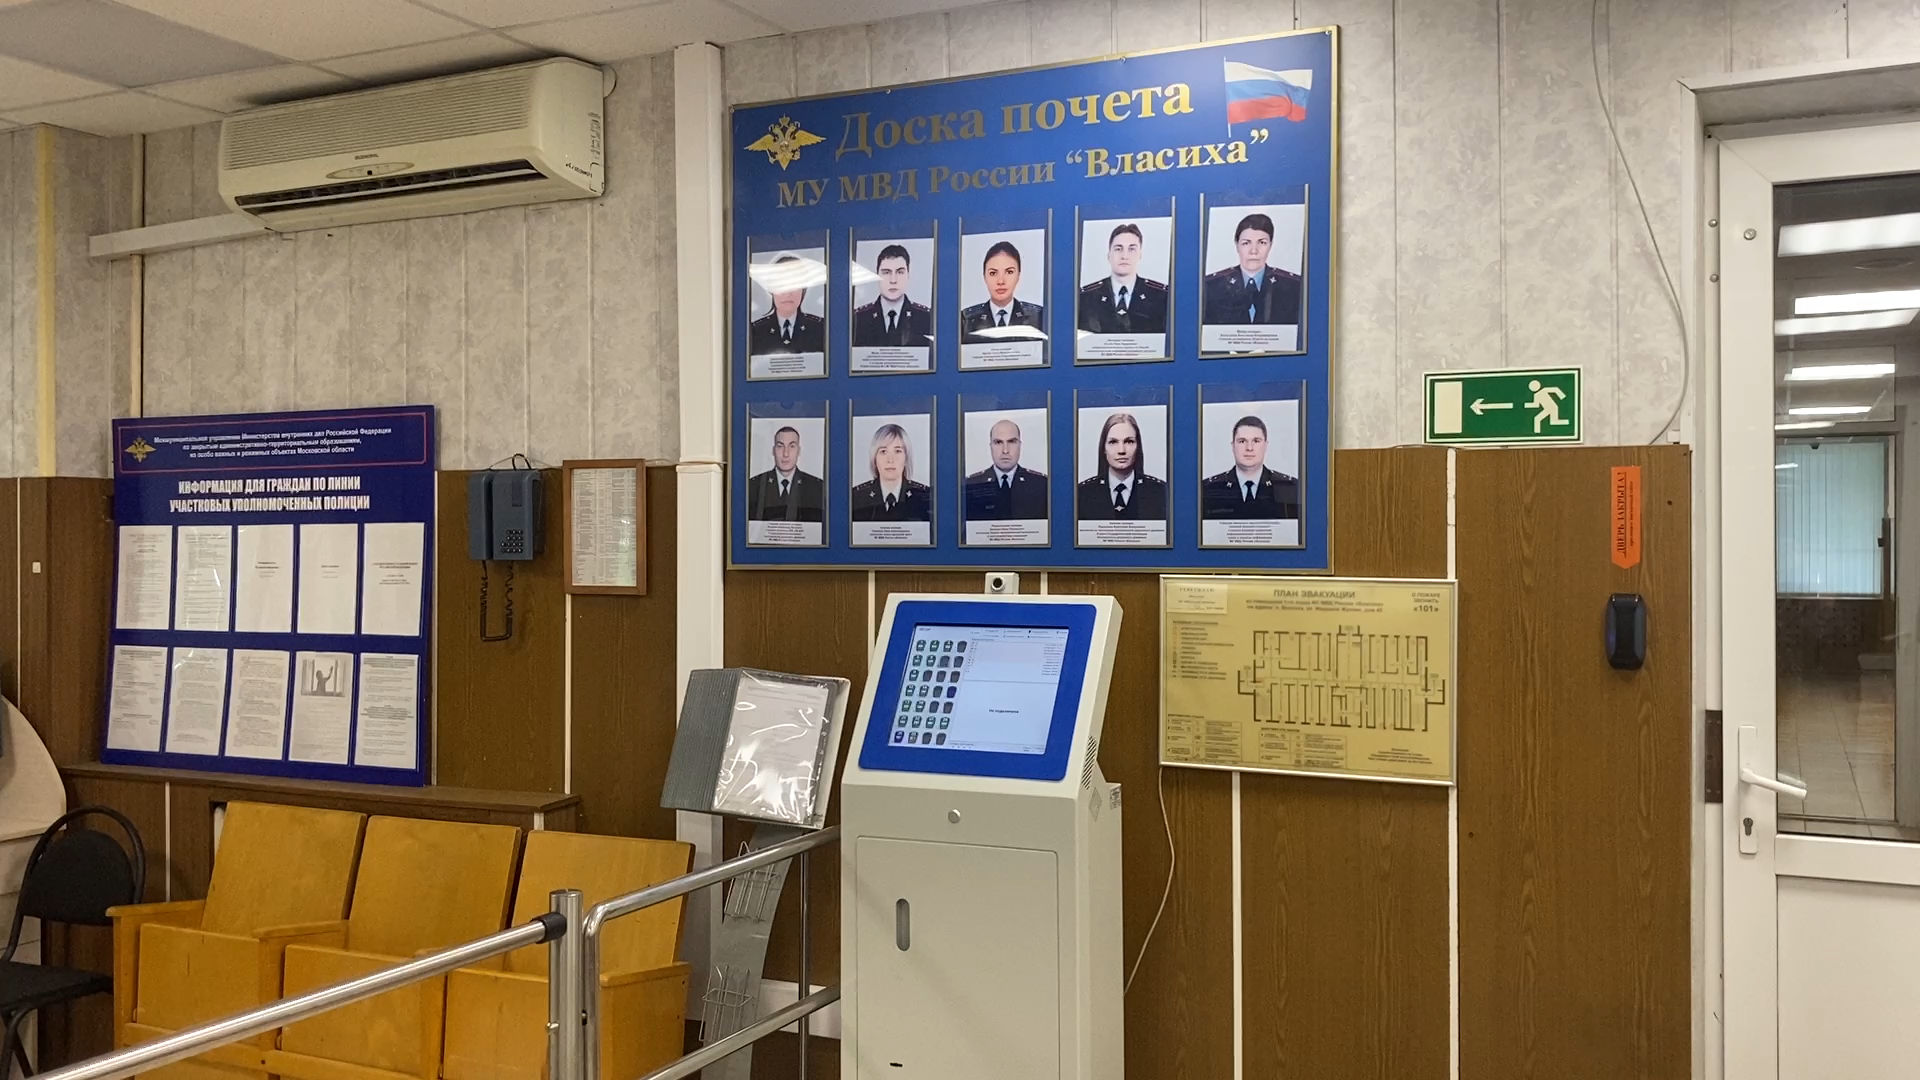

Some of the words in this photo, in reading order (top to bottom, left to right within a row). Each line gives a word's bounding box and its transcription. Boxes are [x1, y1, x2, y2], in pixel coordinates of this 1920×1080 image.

[835, 108, 986, 161] Доска
[1000, 82, 1194, 135] почета
[777, 177, 829, 209] МУ
[838, 167, 918, 204] МВД
[928, 160, 1056, 194] России
[325, 428, 359, 437] Российской
[360, 427, 392, 436] Федерации
[271, 448, 297, 456] объектах
[297, 446, 331, 455] Московской
[331, 446, 355, 454] области
[178, 479, 244, 495] ИНФОРМАЦИЯ
[244, 478, 265, 494] ДЛЯ
[266, 477, 311, 493] ГРАЖДАН
[313, 477, 326, 491] ПО
[327, 476, 361, 491] ЛИНИИ
[169, 498, 231, 513] УЧАСТКОВЫХ
[231, 496, 323, 512] УПОЛНОМОЧЕННЫХ
[323, 495, 371, 512] ПОЛИЦИИ
[1616, 523, 1626, 556] ДВЕРЬ
[1273, 589, 1299, 597] ПЛАН
[1301, 589, 1356, 599] ЭВАКУАЦИИ
